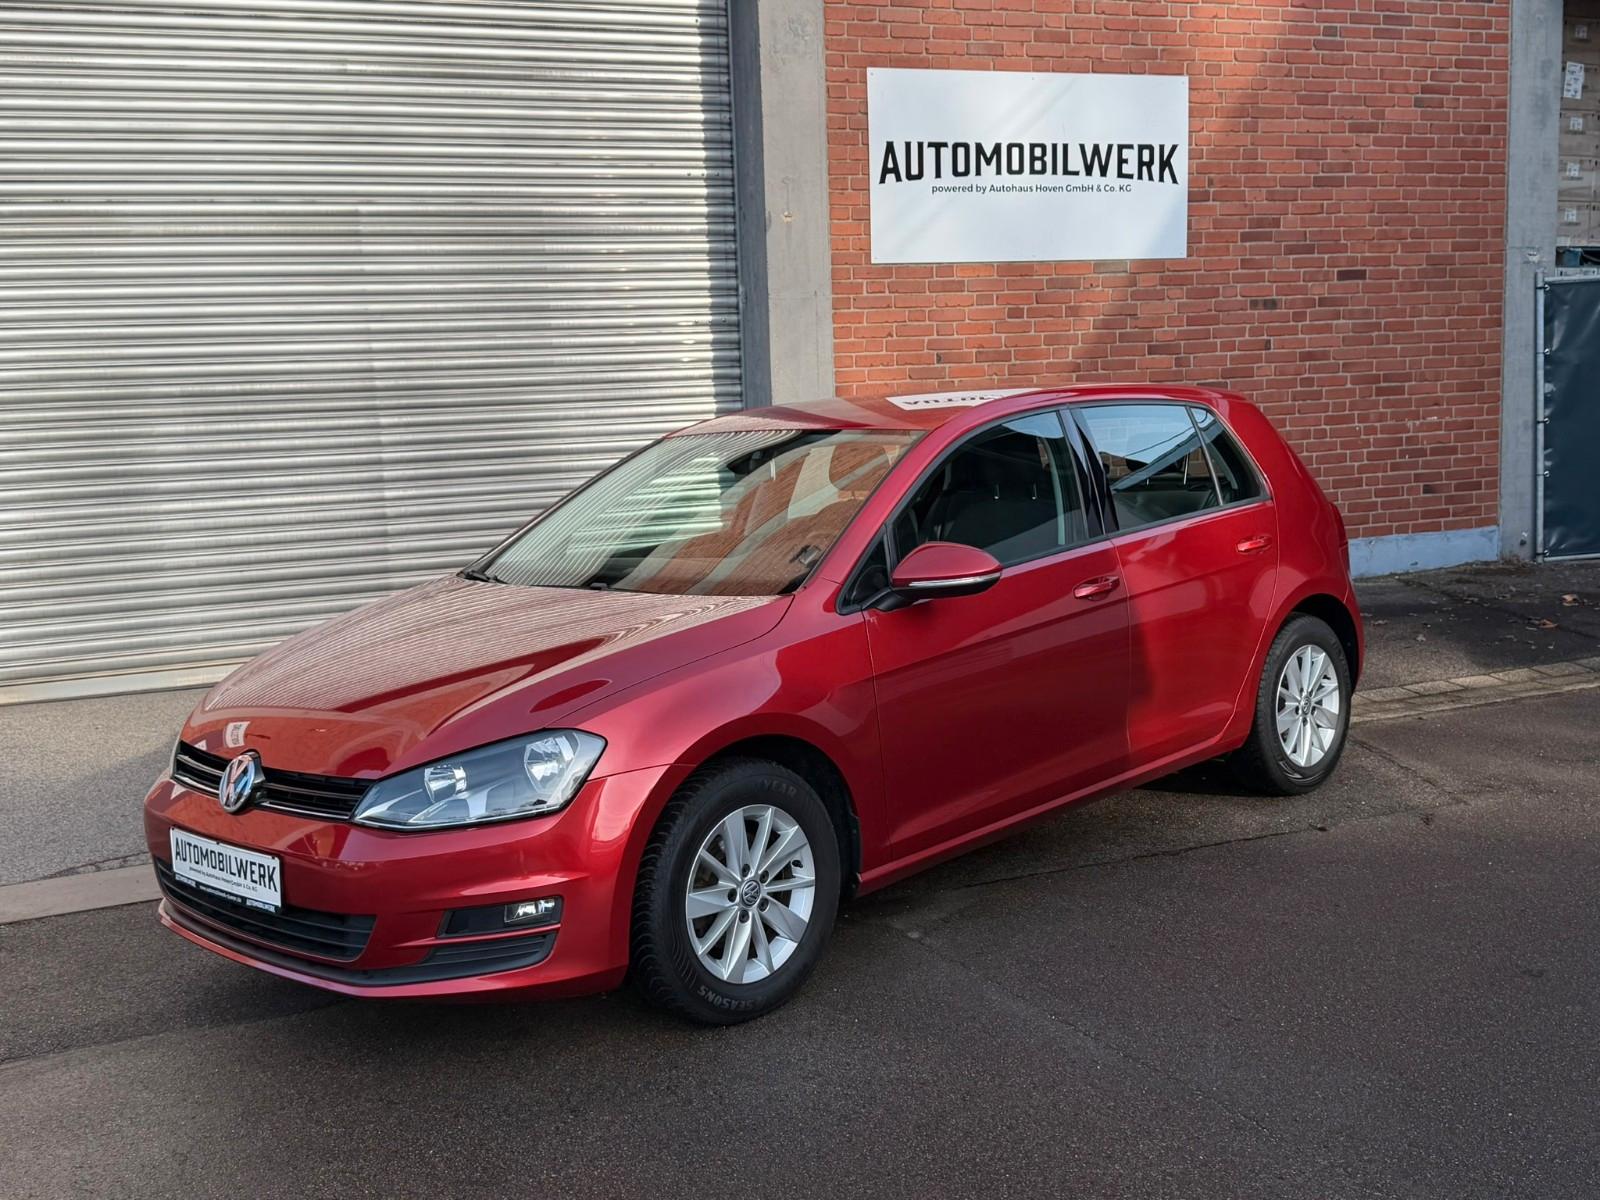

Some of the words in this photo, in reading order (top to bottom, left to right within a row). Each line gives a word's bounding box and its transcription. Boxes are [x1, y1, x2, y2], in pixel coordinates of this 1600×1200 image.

[879, 141, 1179, 185] AUTOMOBILWERK
[931, 183, 973, 195] powered
[975, 183, 987, 195] by
[989, 183, 1034, 193] Autohaus
[1035, 183, 1064, 193] Hoven
[1065, 183, 1094, 193] GmbH
[1096, 184, 1102, 193] &
[1103, 184, 1118, 193] Co.
[1119, 184, 1132, 193] KG
[175, 837, 278, 893] AUTOMOBILWERK
